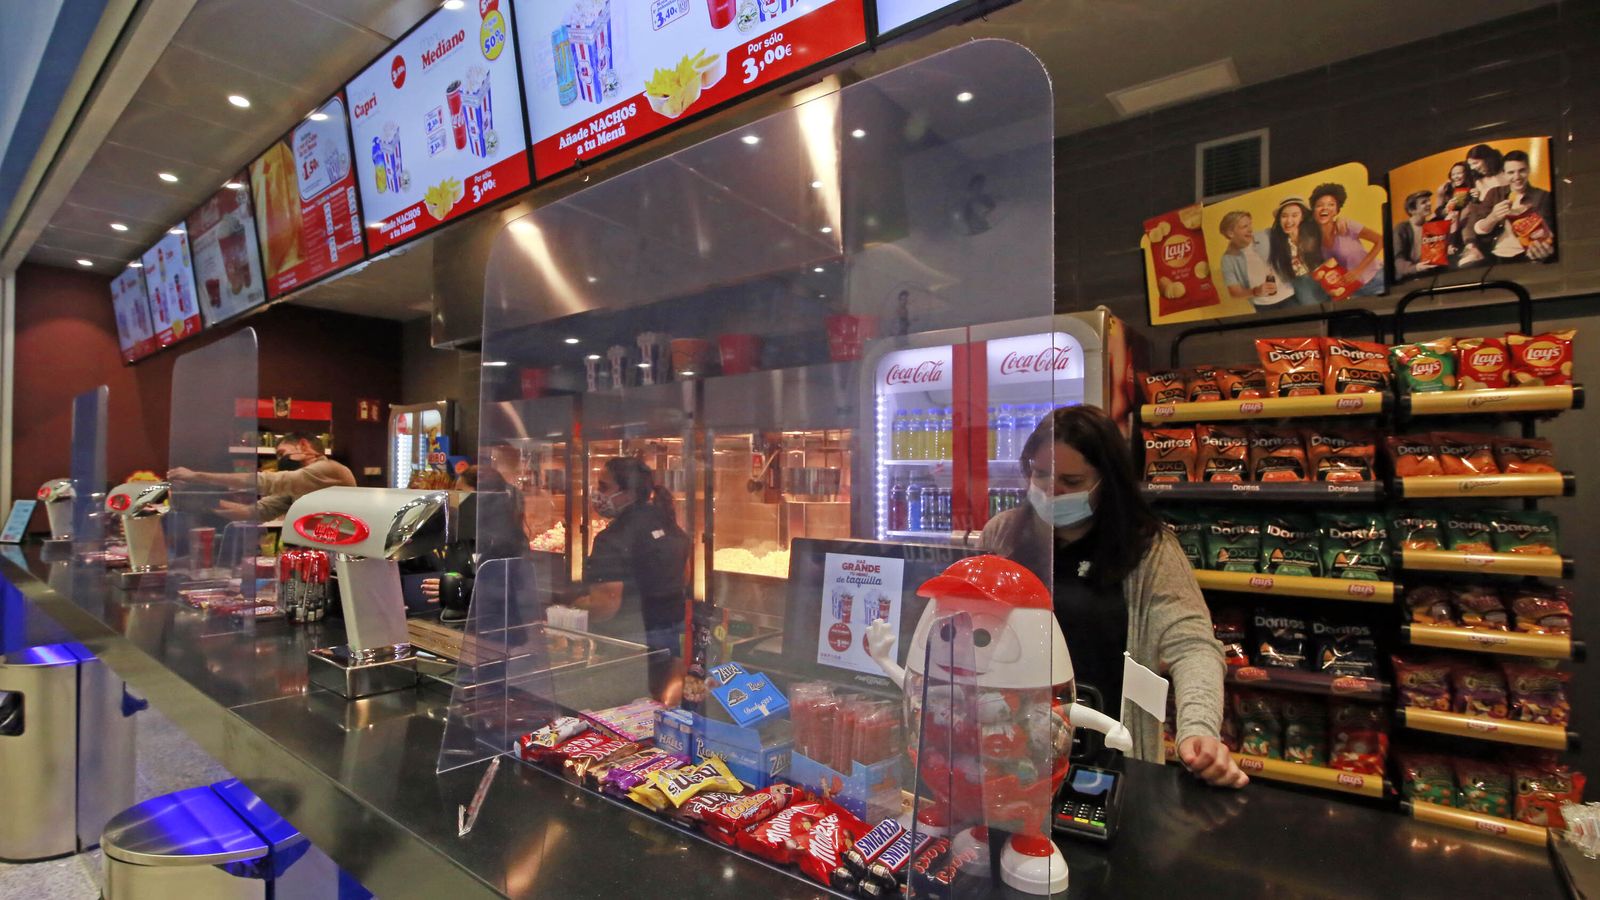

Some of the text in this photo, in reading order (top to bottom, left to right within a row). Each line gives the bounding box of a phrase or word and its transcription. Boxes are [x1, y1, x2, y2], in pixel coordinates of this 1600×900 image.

[421, 28, 466, 70] Mediano
[484, 30, 504, 54] 50%
[747, 32, 784, 56] Por sólo
[741, 43, 792, 84] 3,00€
[354, 92, 378, 119] Capri
[558, 103, 637, 150] Añade NACHOS
[576, 122, 627, 155] a tu Menú
[473, 170, 493, 184] Por sólo
[395, 206, 422, 227] NACHOS
[1000, 345, 1073, 375] Coca-Cola
[1268, 349, 1321, 363] Doritos
[1329, 345, 1386, 360] Doritos
[1472, 350, 1504, 366] Lay's
[1526, 346, 1561, 362] Lay's
[886, 359, 945, 385] Coca-Cola
[1410, 361, 1441, 376] Lay's
[1145, 439, 1192, 449] Doritos
[1231, 484, 1260, 492] Doritos
[1327, 485, 1360, 493] Doritos
[1329, 527, 1389, 540] Doritos
[841, 562, 881, 574] GRANDE
[836, 575, 882, 589] de taquilla
[1254, 615, 1306, 630] Doritos
[1312, 622, 1372, 636] Doritos
[659, 733, 684, 752] HALLS
[667, 763, 722, 797] m&m's
[856, 818, 901, 857] SNICKERS
